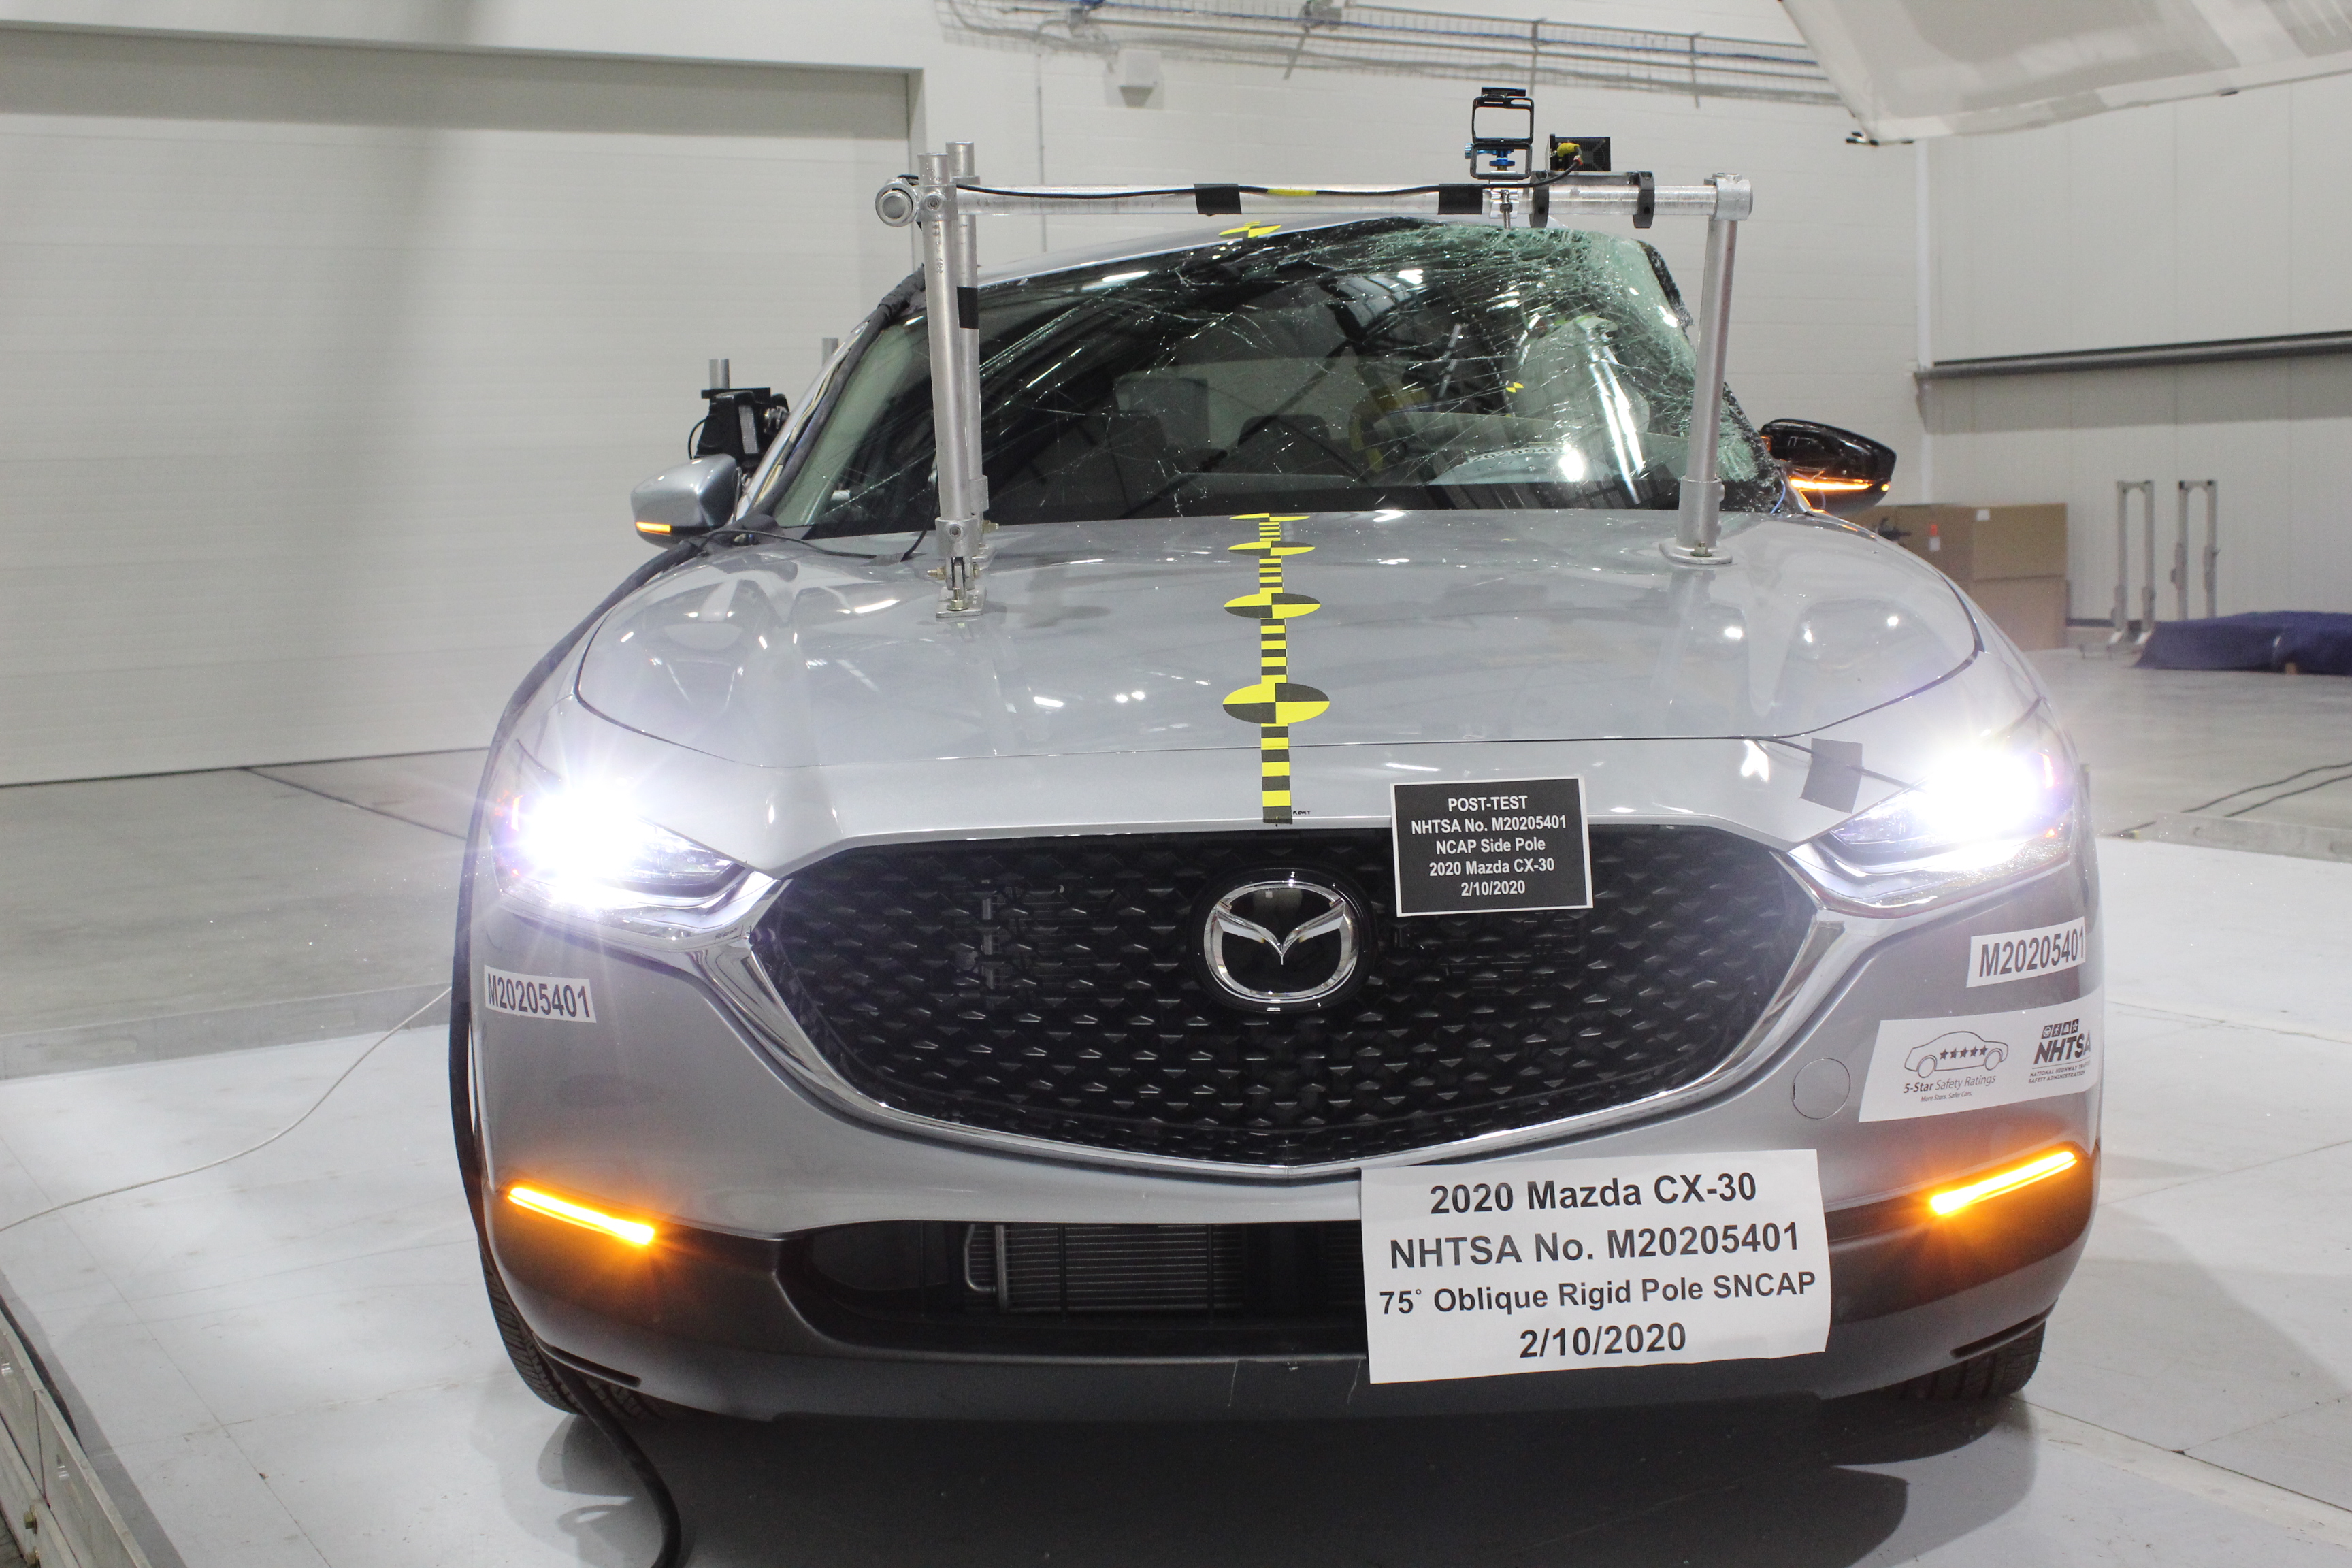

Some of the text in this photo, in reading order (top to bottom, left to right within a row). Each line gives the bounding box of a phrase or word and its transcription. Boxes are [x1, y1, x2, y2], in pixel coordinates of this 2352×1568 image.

[1448, 795, 1529, 812] POST-TEST
[1411, 814, 1567, 834] NHTSA No. M20205401
[1436, 836, 1546, 855] NCAP Side Pole
[1429, 857, 1555, 877] 2020 Mazda CX-30
[1460, 879, 1526, 896] 2/10/2020
[1978, 925, 2085, 977] M20205401
[487, 973, 590, 1018] M20205401
[2034, 1029, 2091, 1065] NHTSA
[2028, 1075, 2046, 1084] SAFETY
[2029, 1068, 2054, 1077] NATIONAL
[1903, 1074, 1997, 1094] 5-Star Safety Ratings
[1948, 1091, 1961, 1099] Safer
[1430, 1172, 1756, 1215] 2020 Mazda CX-30
[1390, 1222, 1798, 1269] NHTSA No. M20205401
[1379, 1271, 1816, 1316] 75° Oblique Rigid Pole SNCAP
[1519, 1322, 1686, 1358] 2/10/2020
